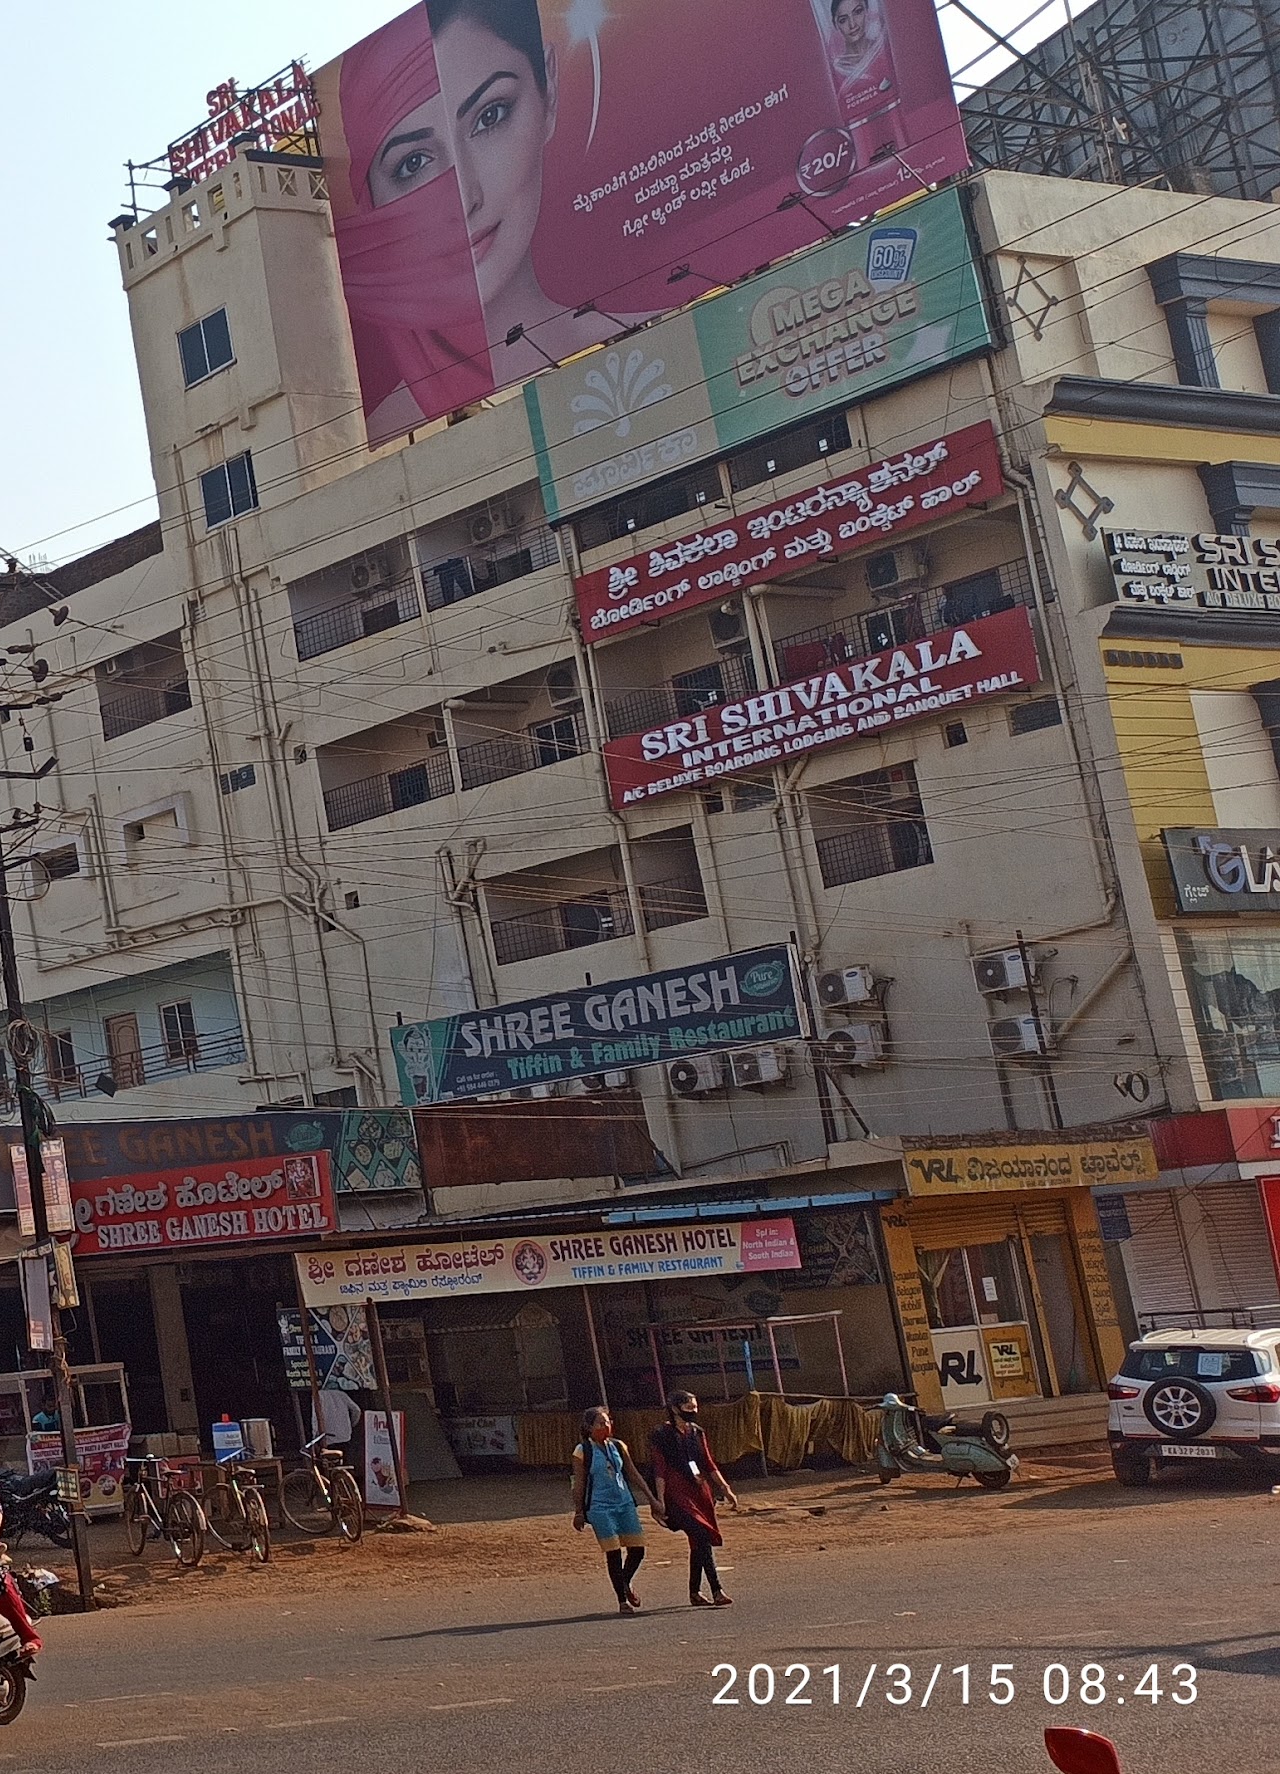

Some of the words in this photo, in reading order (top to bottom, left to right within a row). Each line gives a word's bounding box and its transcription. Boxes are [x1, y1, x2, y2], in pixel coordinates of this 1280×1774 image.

[206, 77, 239, 117] SRI
[872, 245, 906, 269] 60%
[773, 271, 870, 336] MEGA
[737, 283, 916, 385] EXCHANGE
[786, 334, 886, 396] OFFER
[1197, 533, 1253, 564] SRI
[609, 567, 639, 600] ಶ್ರೀ
[1212, 567, 1280, 594] INTE
[640, 714, 710, 762] SRI
[721, 630, 982, 736] SHIVAKALA
[648, 767, 703, 796] DELUXE
[706, 744, 781, 777] BOARDING
[784, 722, 854, 753] LODGING
[857, 710, 891, 732] AND
[894, 685, 972, 721] BANQUET
[976, 670, 1024, 692] HALL
[682, 677, 943, 768] INTERNATIONAL
[750, 971, 773, 983] Pure
[461, 1003, 575, 1059] SHREE
[583, 966, 739, 1032] GANESH
[507, 1051, 562, 1081] Tiffin
[570, 1046, 586, 1070] &
[592, 1034, 661, 1067] Family
[669, 1005, 795, 1050] Restaurant
[117, 1121, 274, 1166] GANESH
[909, 1158, 962, 1183] VRL
[96, 1183, 168, 1216] ಗಣೇಶ
[98, 1222, 163, 1248] SHREE
[166, 1211, 248, 1241] GANESH
[252, 1203, 328, 1233] HOTEL
[550, 1236, 605, 1262] SHREE
[609, 1230, 681, 1257] GANESH
[683, 1227, 737, 1251] HOTEL
[742, 1240, 764, 1250] North
[765, 1238, 787, 1249] Indian
[748, 1250, 770, 1261] South
[308, 1256, 335, 1284] ಶ್ರೀ
[345, 1249, 407, 1277] ಗಣೇಶ
[571, 1264, 605, 1279] TIFFIN
[607, 1264, 616, 1276] &
[618, 1261, 656, 1276] FAMILY
[658, 1256, 723, 1273] RESTAURANT
